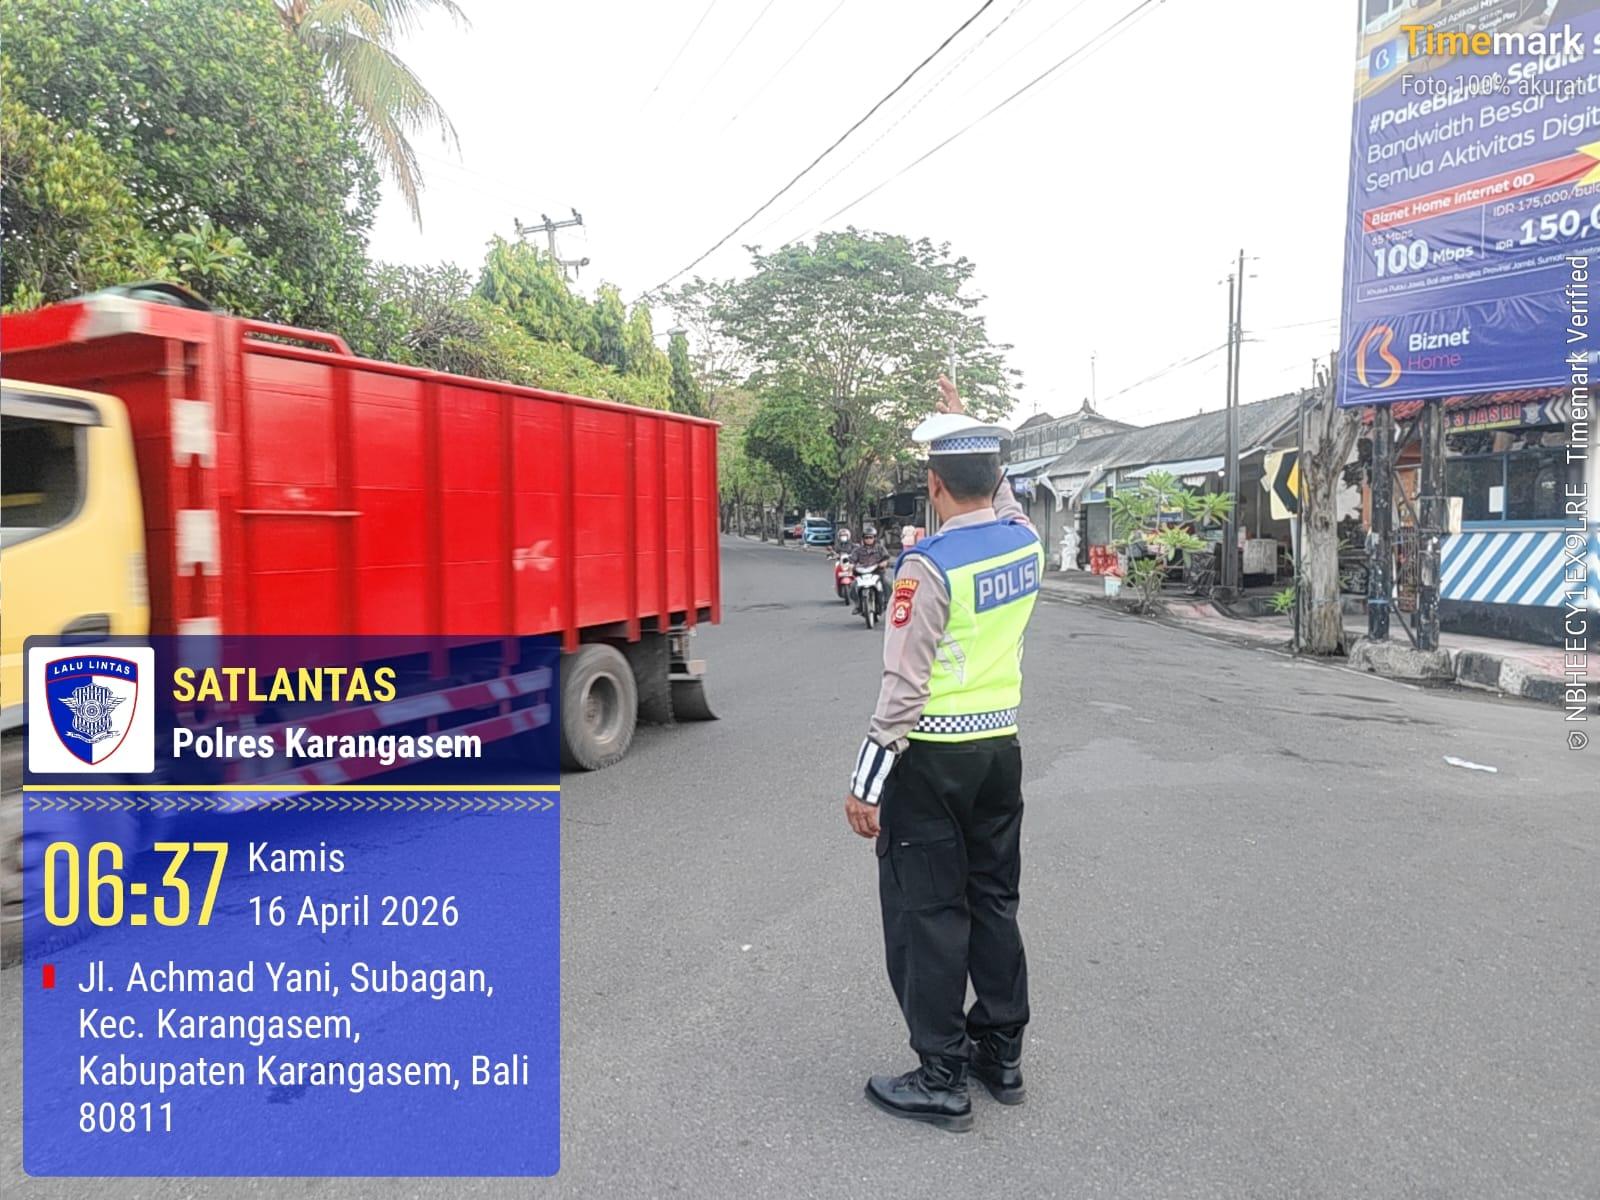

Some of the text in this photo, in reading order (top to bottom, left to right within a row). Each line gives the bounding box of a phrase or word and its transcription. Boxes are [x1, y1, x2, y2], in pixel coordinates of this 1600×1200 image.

[1366, 105, 1600, 192] Semua Aktivitas Digit
[1367, 113, 1474, 164] Bandwidth
[1480, 94, 1549, 128] Besar
[1371, 206, 1410, 225] Biznet
[1412, 198, 1451, 216] Home
[1454, 179, 1510, 205] Internet
[1493, 202, 1516, 217] IDR
[1374, 239, 1475, 278] 100 Mbps
[1495, 239, 1514, 251] IDR
[1408, 328, 1470, 352] Biznet
[1408, 351, 1462, 370] Home
[978, 560, 1039, 606] POLISI
